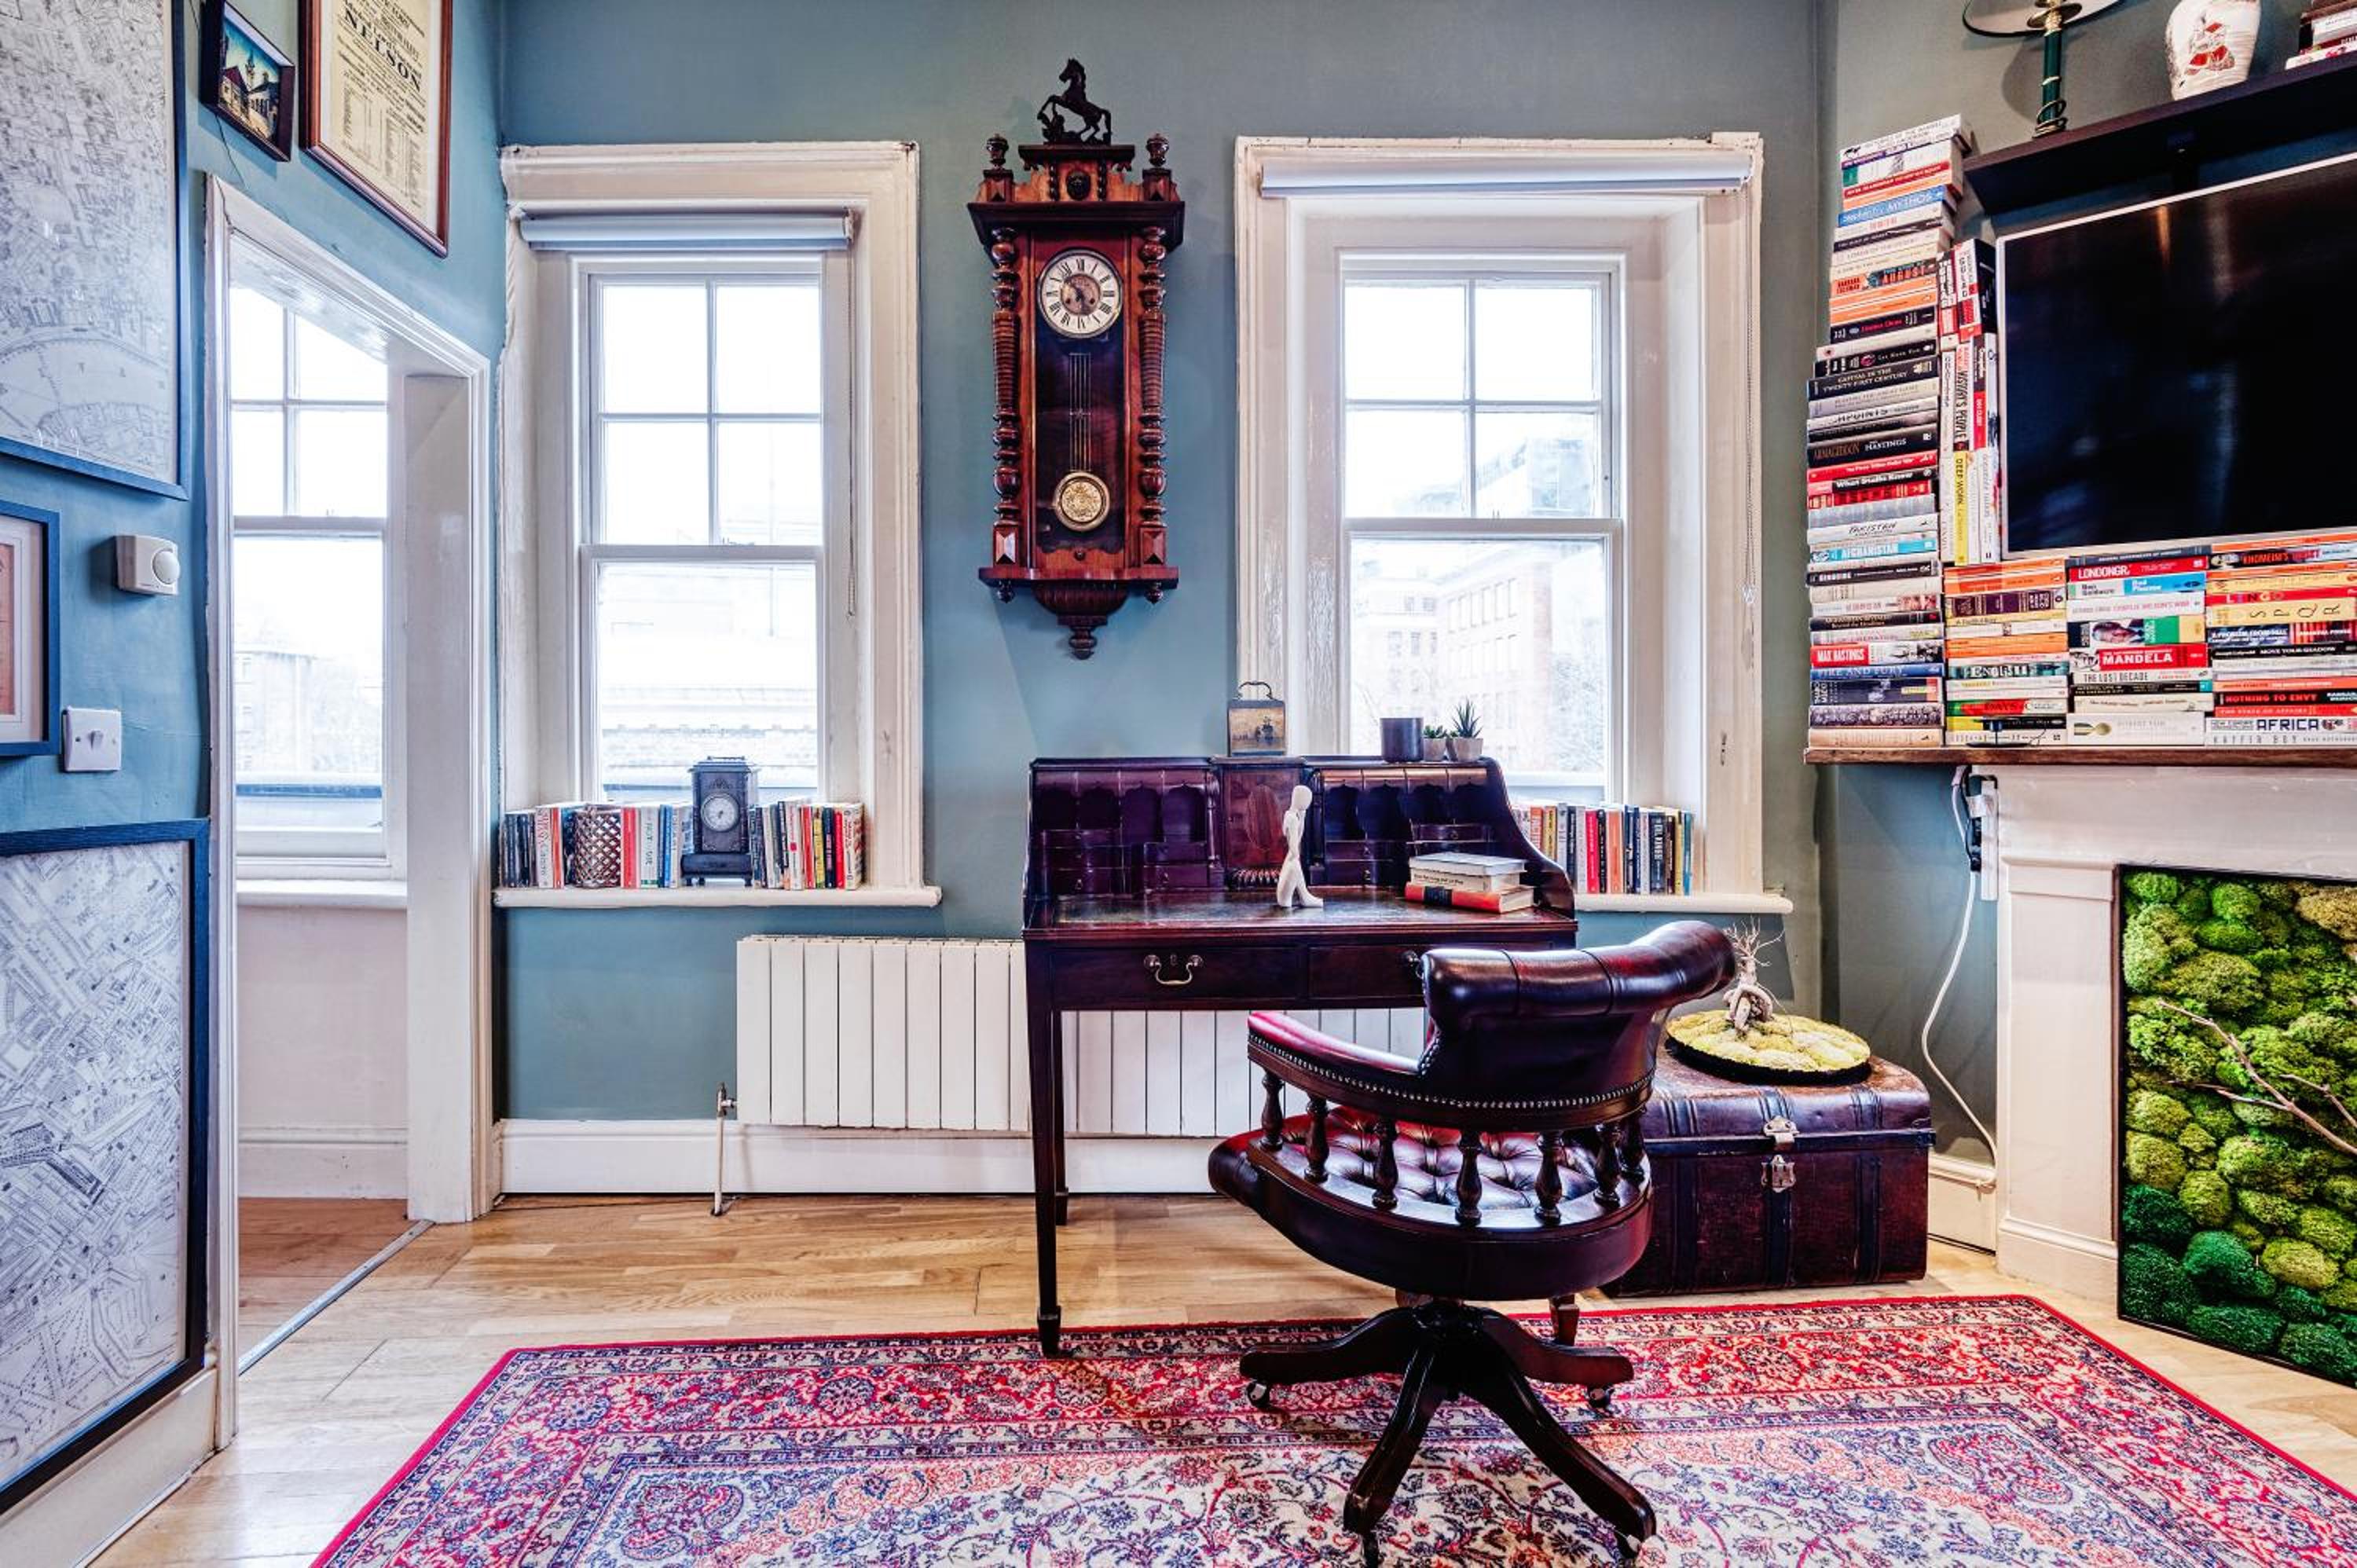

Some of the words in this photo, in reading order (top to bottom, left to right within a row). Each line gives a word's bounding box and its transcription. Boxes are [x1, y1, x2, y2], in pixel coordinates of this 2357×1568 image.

[345, 9, 420, 92] NELSON
[1882, 266, 1925, 284] AUGUST
[1956, 410, 1967, 438] PEOPLE
[1864, 438, 1908, 452] HASTINGS
[1836, 478, 1860, 489] What
[1956, 482, 1964, 504] WORK
[1849, 522, 1897, 534] PAKISTAN
[2226, 592, 2285, 603] LINGO
[1817, 650, 1832, 662] MAX
[1834, 649, 1864, 661] HASTINGS
[2102, 654, 2172, 665] MANDELA
[1818, 668, 1843, 677] FIRE
[1846, 666, 1871, 675] AND
[1874, 665, 1904, 673] FURY
[2084, 673, 2097, 682] THE
[2099, 673, 2117, 682] LOST
[2120, 672, 2148, 681] DECADE
[2256, 719, 2319, 731] AFRICA
